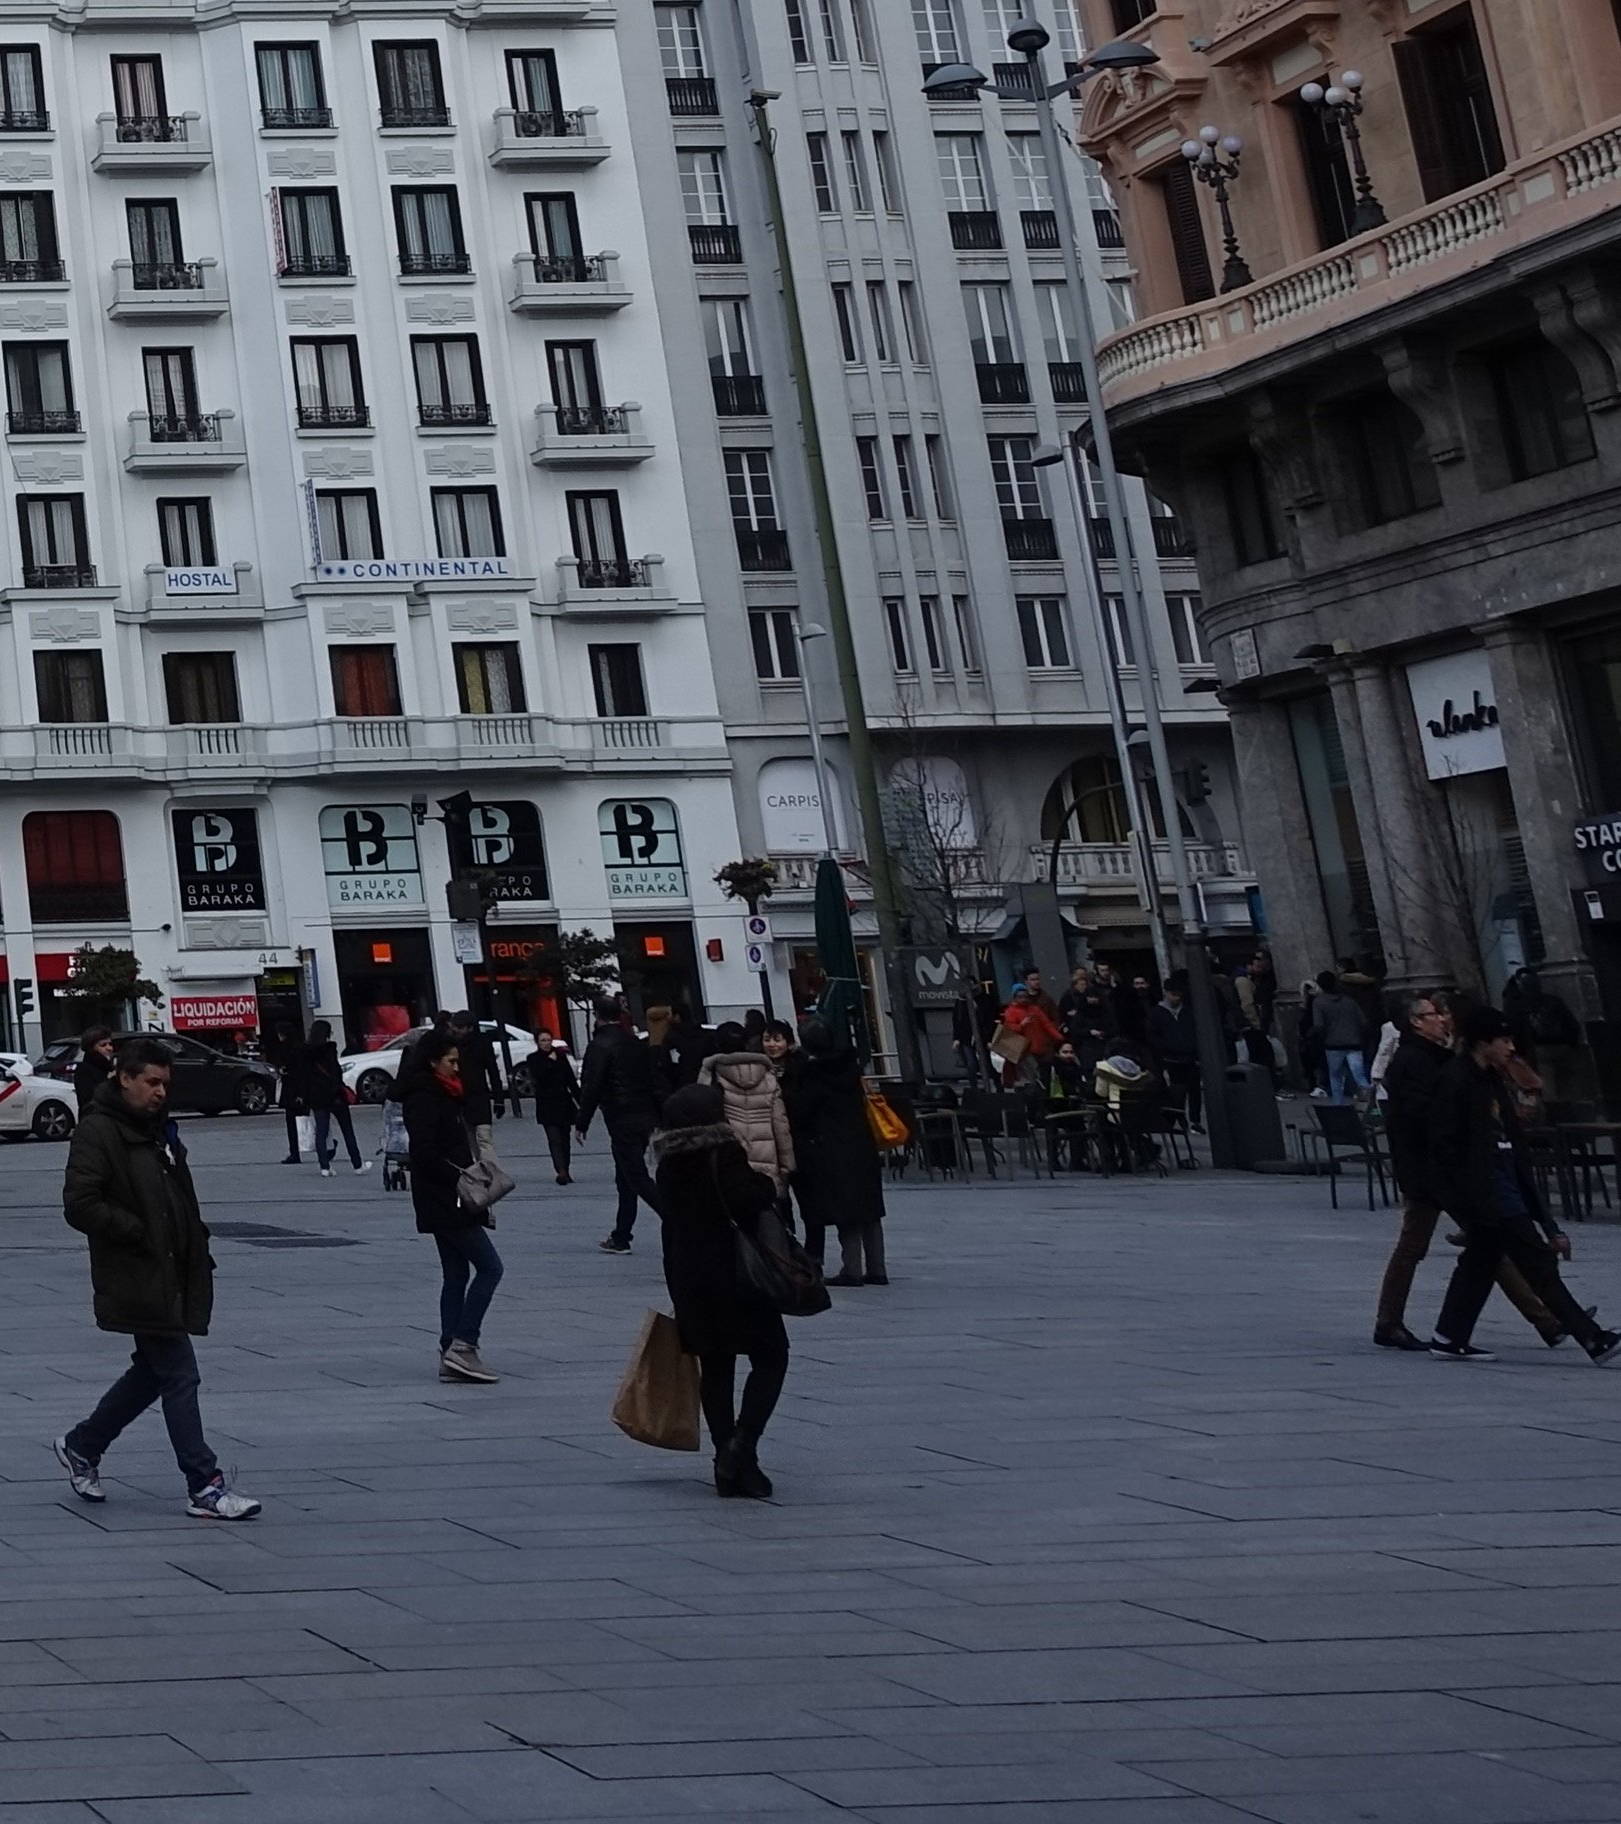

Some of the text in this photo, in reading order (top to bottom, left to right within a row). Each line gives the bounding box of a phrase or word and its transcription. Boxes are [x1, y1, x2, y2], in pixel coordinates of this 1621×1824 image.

[168, 561, 508, 588] HOSTAL CONTINENTAL
[767, 794, 820, 808] CARPIS
[610, 872, 677, 884] GRUPO
[187, 882, 254, 896] GRUPO
[339, 879, 406, 890] GRUPO
[612, 882, 678, 894] BARAKA
[188, 894, 255, 906] BARAKA
[340, 890, 407, 902] BARAKA
[258, 952, 278, 964] 44
[918, 989, 959, 1000] movista
[173, 999, 256, 1019] LIQUIDACIÓN
[187, 1017, 244, 1027] POR REFORMA
